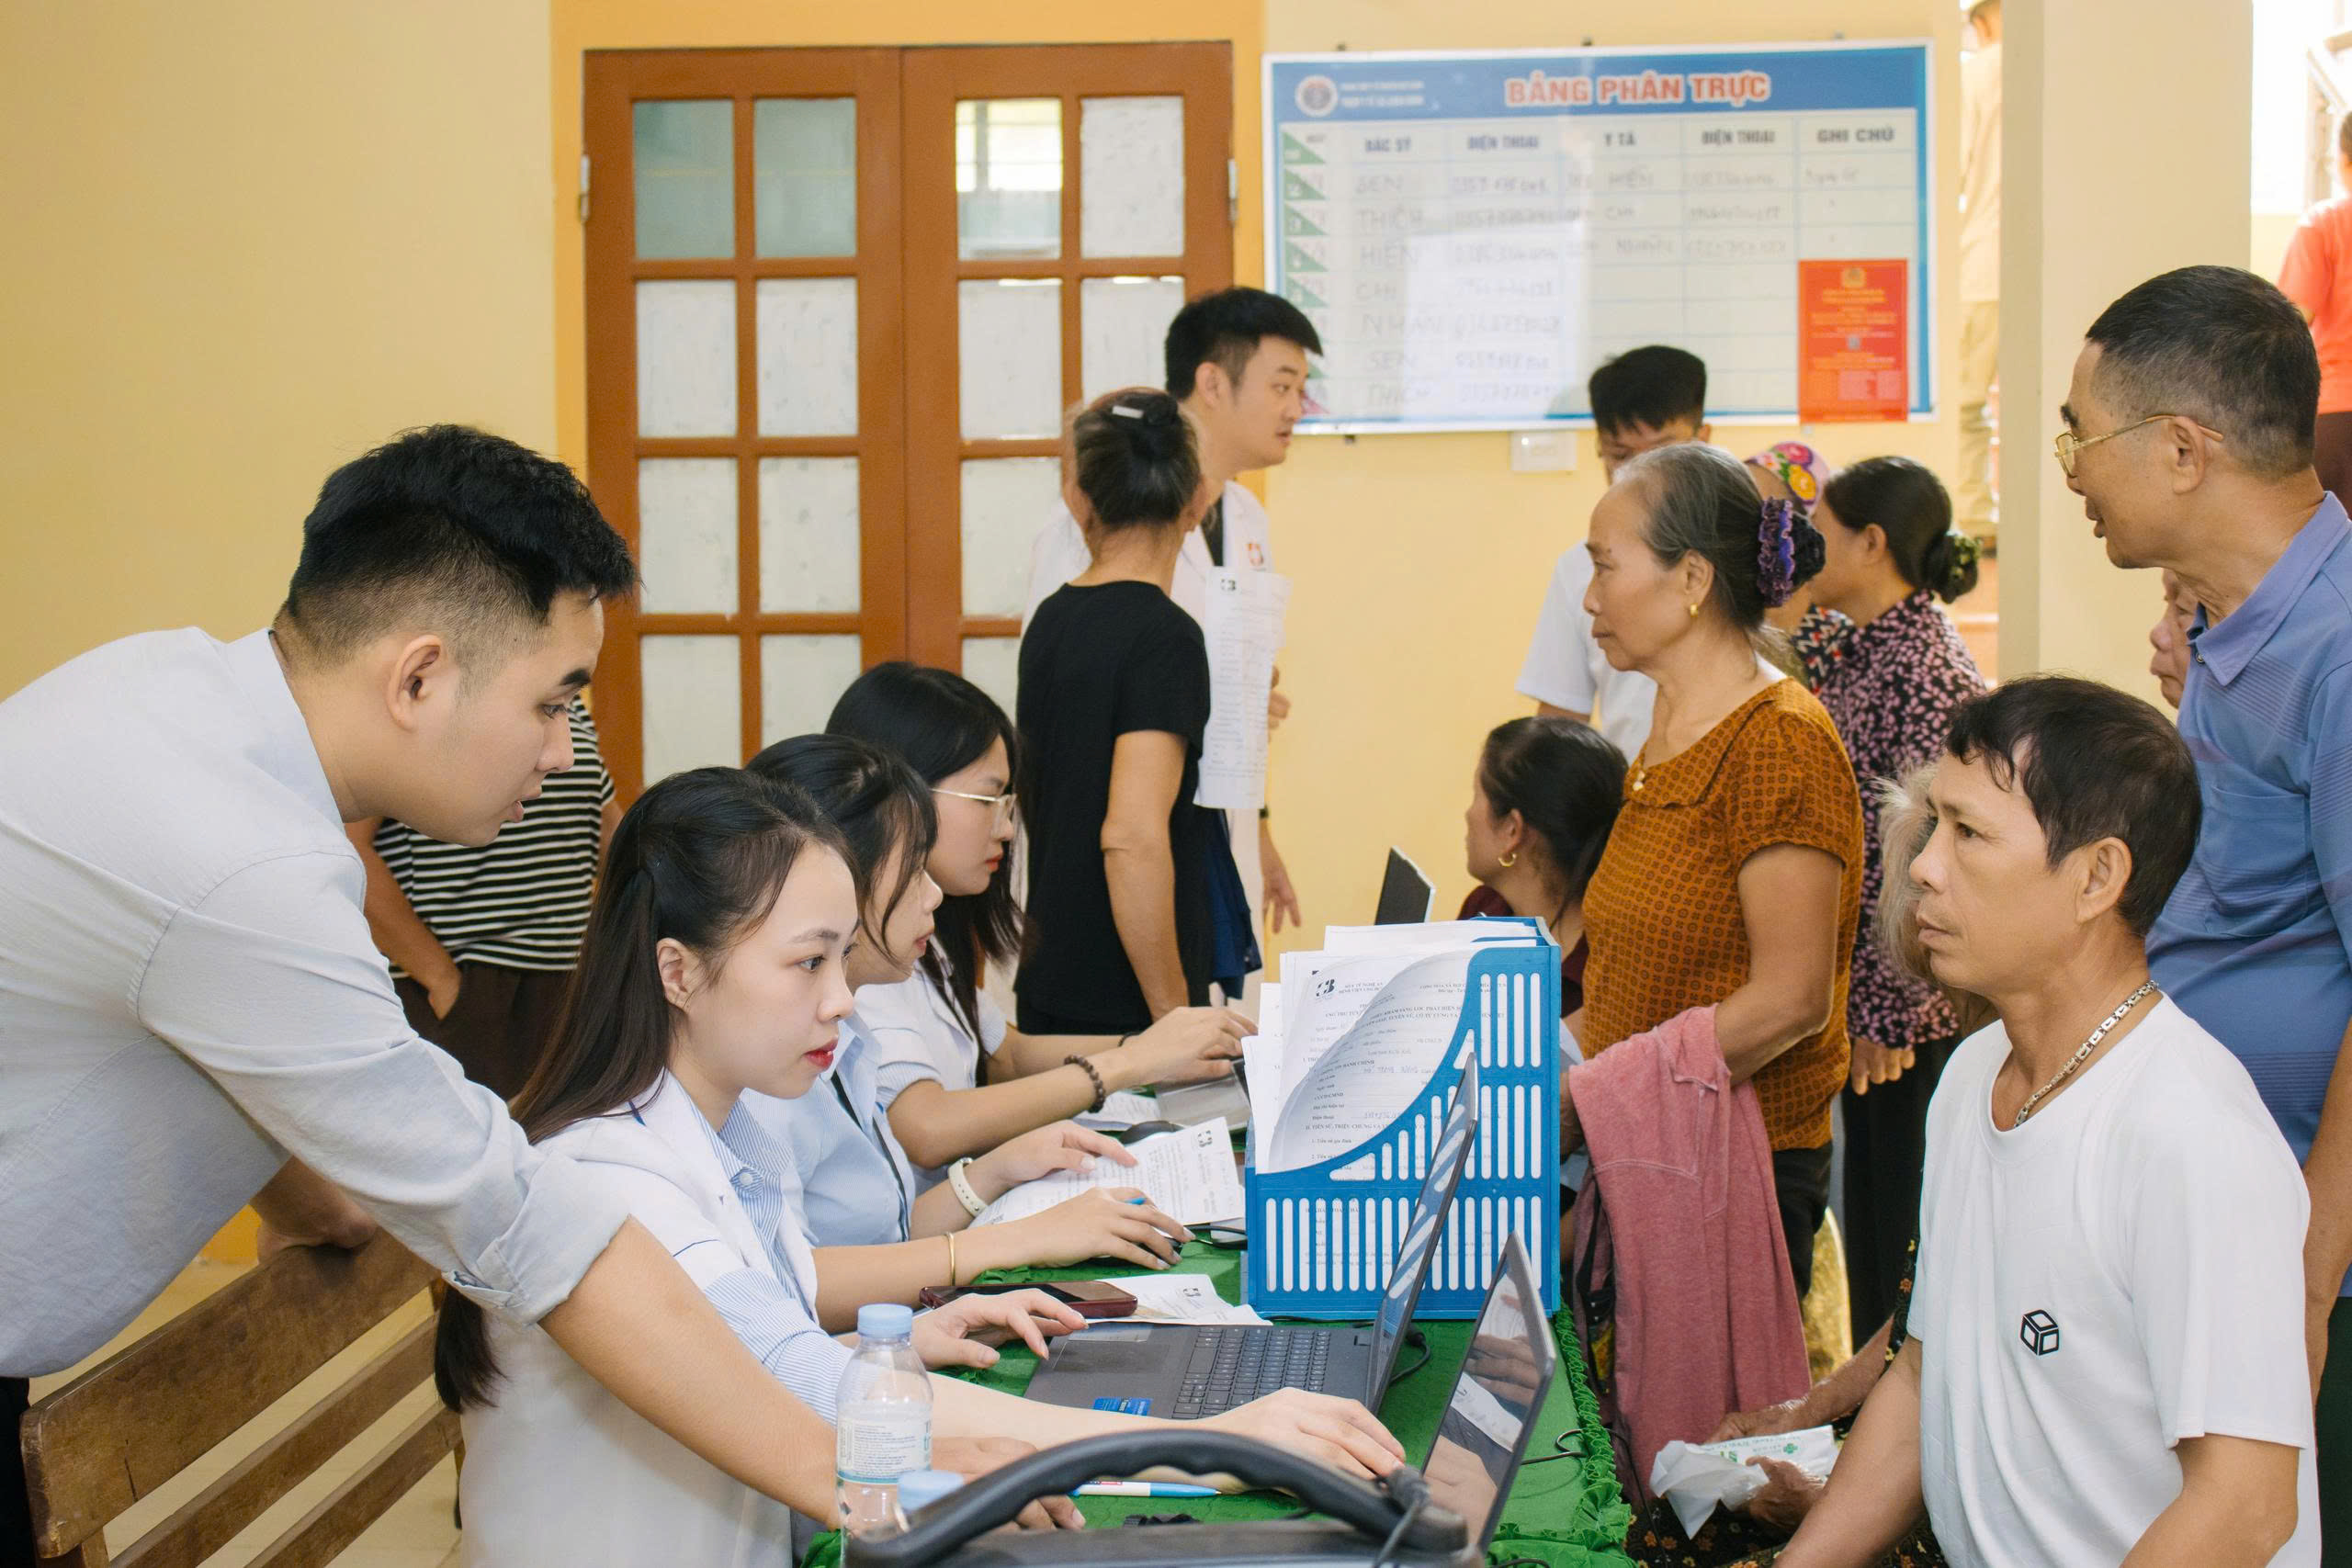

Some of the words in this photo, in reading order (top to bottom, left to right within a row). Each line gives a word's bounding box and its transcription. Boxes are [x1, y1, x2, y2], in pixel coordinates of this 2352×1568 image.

[1507, 71, 1590, 105] BẢNG
[1599, 72, 1682, 103] PHÂN
[1689, 72, 1769, 106] TRỰC
[1816, 129, 1849, 142] GHI
